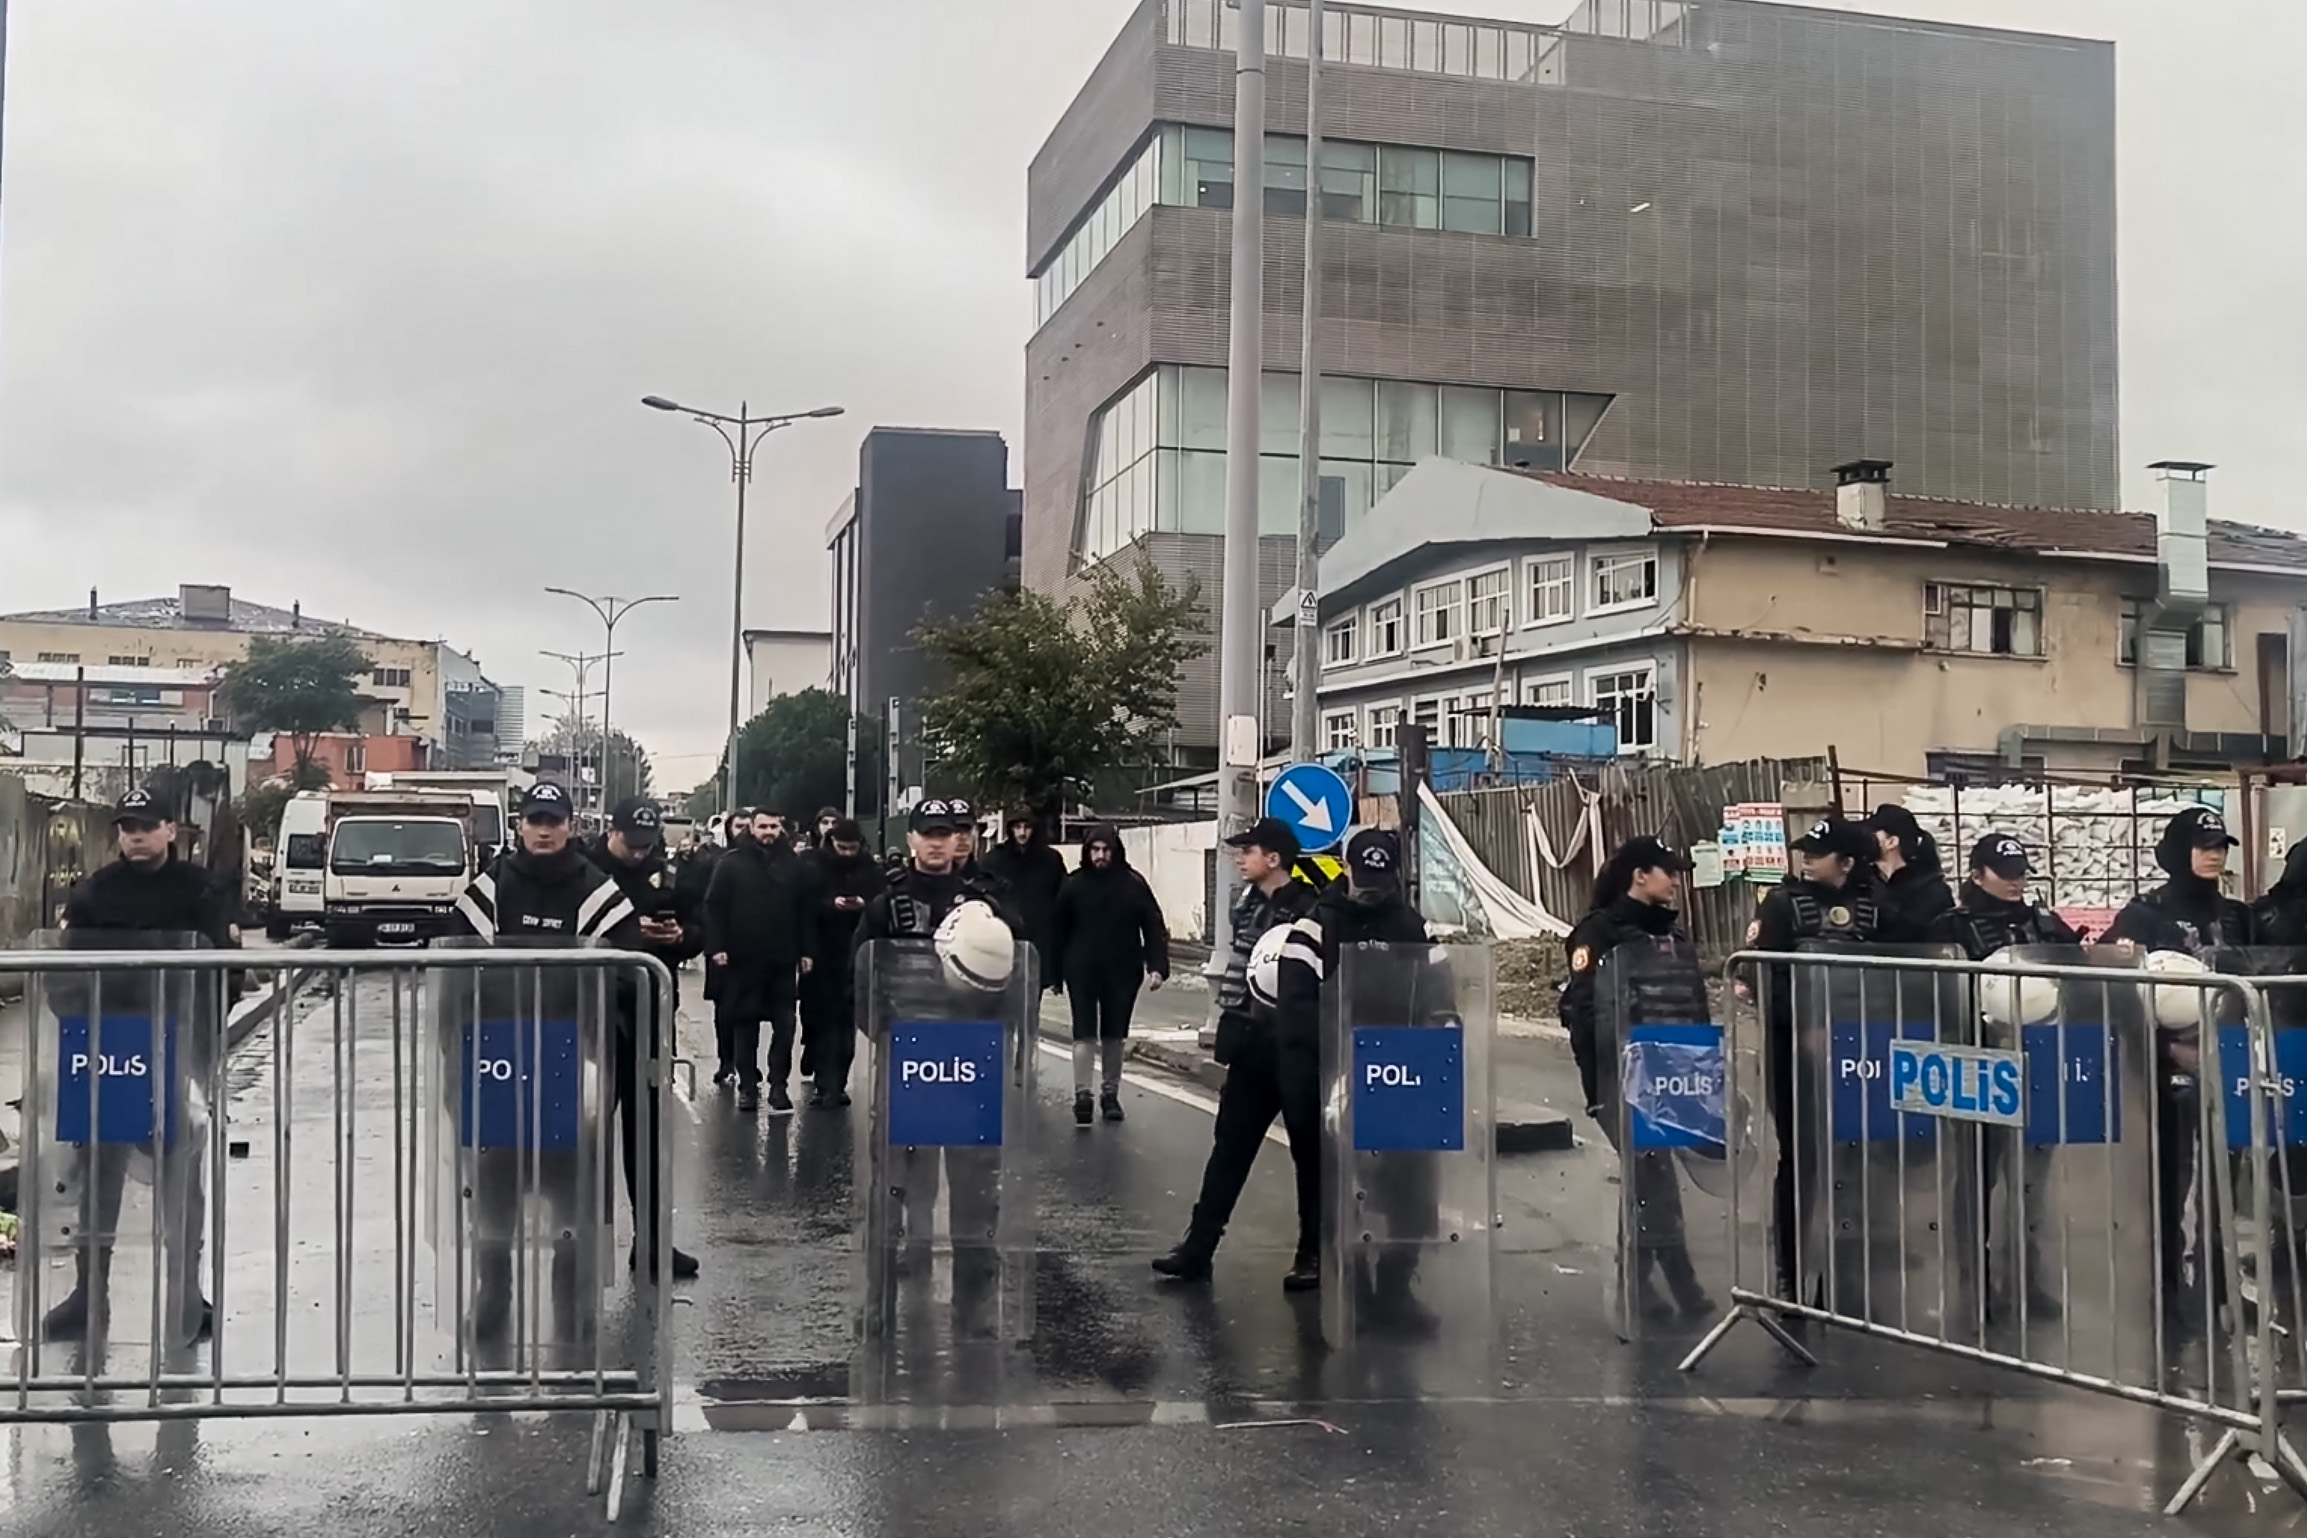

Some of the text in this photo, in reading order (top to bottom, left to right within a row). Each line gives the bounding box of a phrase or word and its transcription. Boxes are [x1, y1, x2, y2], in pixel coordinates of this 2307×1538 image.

[902, 1056, 977, 1083] POLİS
[1893, 1049, 2018, 1116] POLİS
[1655, 1071, 1713, 1096] POLİS
